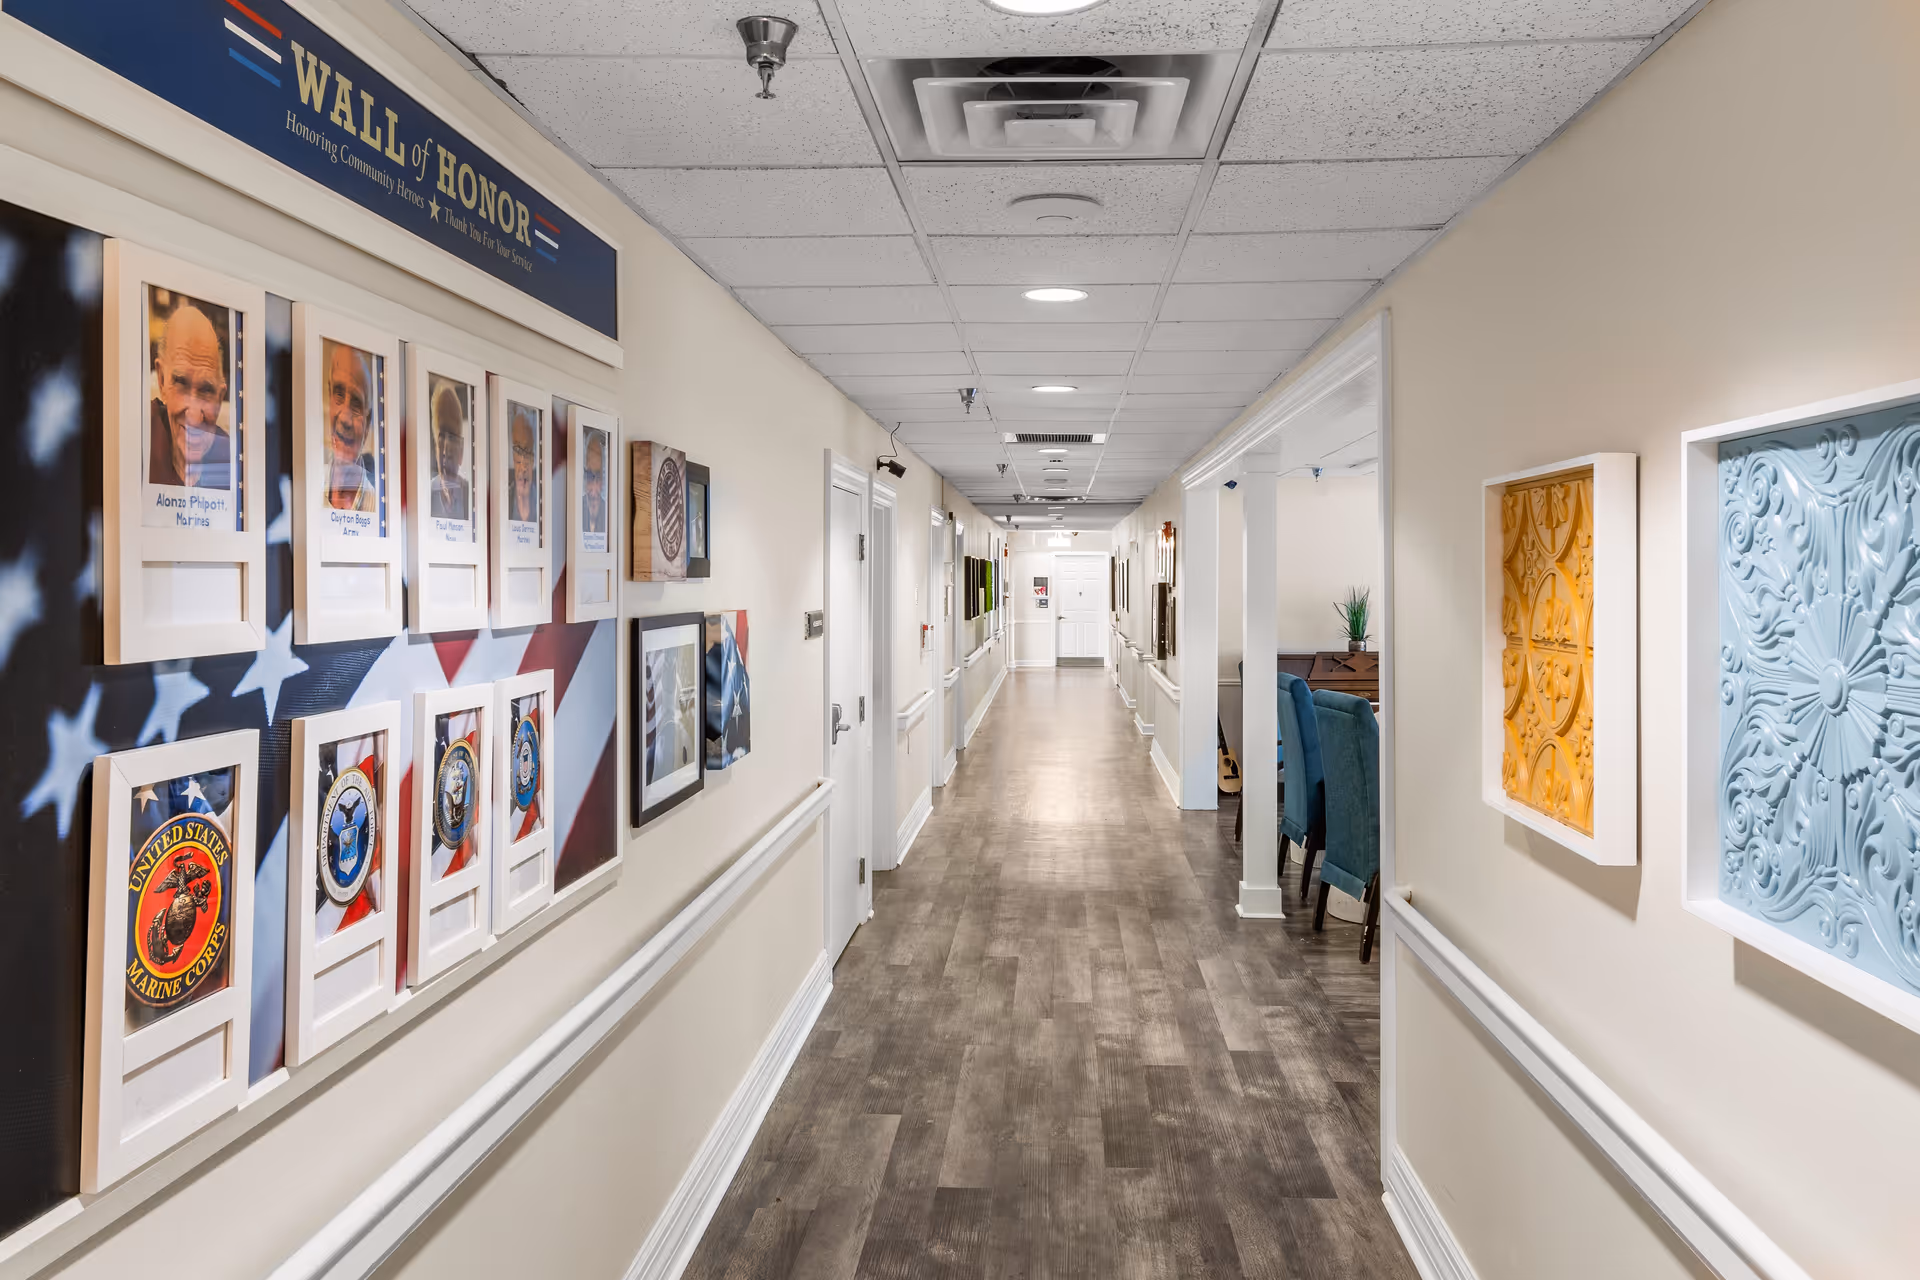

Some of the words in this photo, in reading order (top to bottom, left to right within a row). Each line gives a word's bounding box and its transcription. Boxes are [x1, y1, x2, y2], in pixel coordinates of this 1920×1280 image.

[286, 109, 338, 163] Honoring
[340, 144, 395, 194] Community
[397, 177, 425, 209] Heroes
[290, 40, 405, 167] WALL
[412, 137, 433, 181] of
[437, 144, 532, 248] HONOR
[444, 206, 468, 235] Thank
[469, 221, 482, 243] You
[483, 230, 496, 250] For
[496, 238, 511, 255] Your
[511, 248, 533, 273] Service
[156, 492, 187, 508] Alonzo
[176, 511, 210, 527] Marines
[129, 824, 184, 893] UNITED
[185, 821, 229, 868] STATES
[126, 957, 183, 1000] MARINE
[184, 922, 226, 988] CORPS
